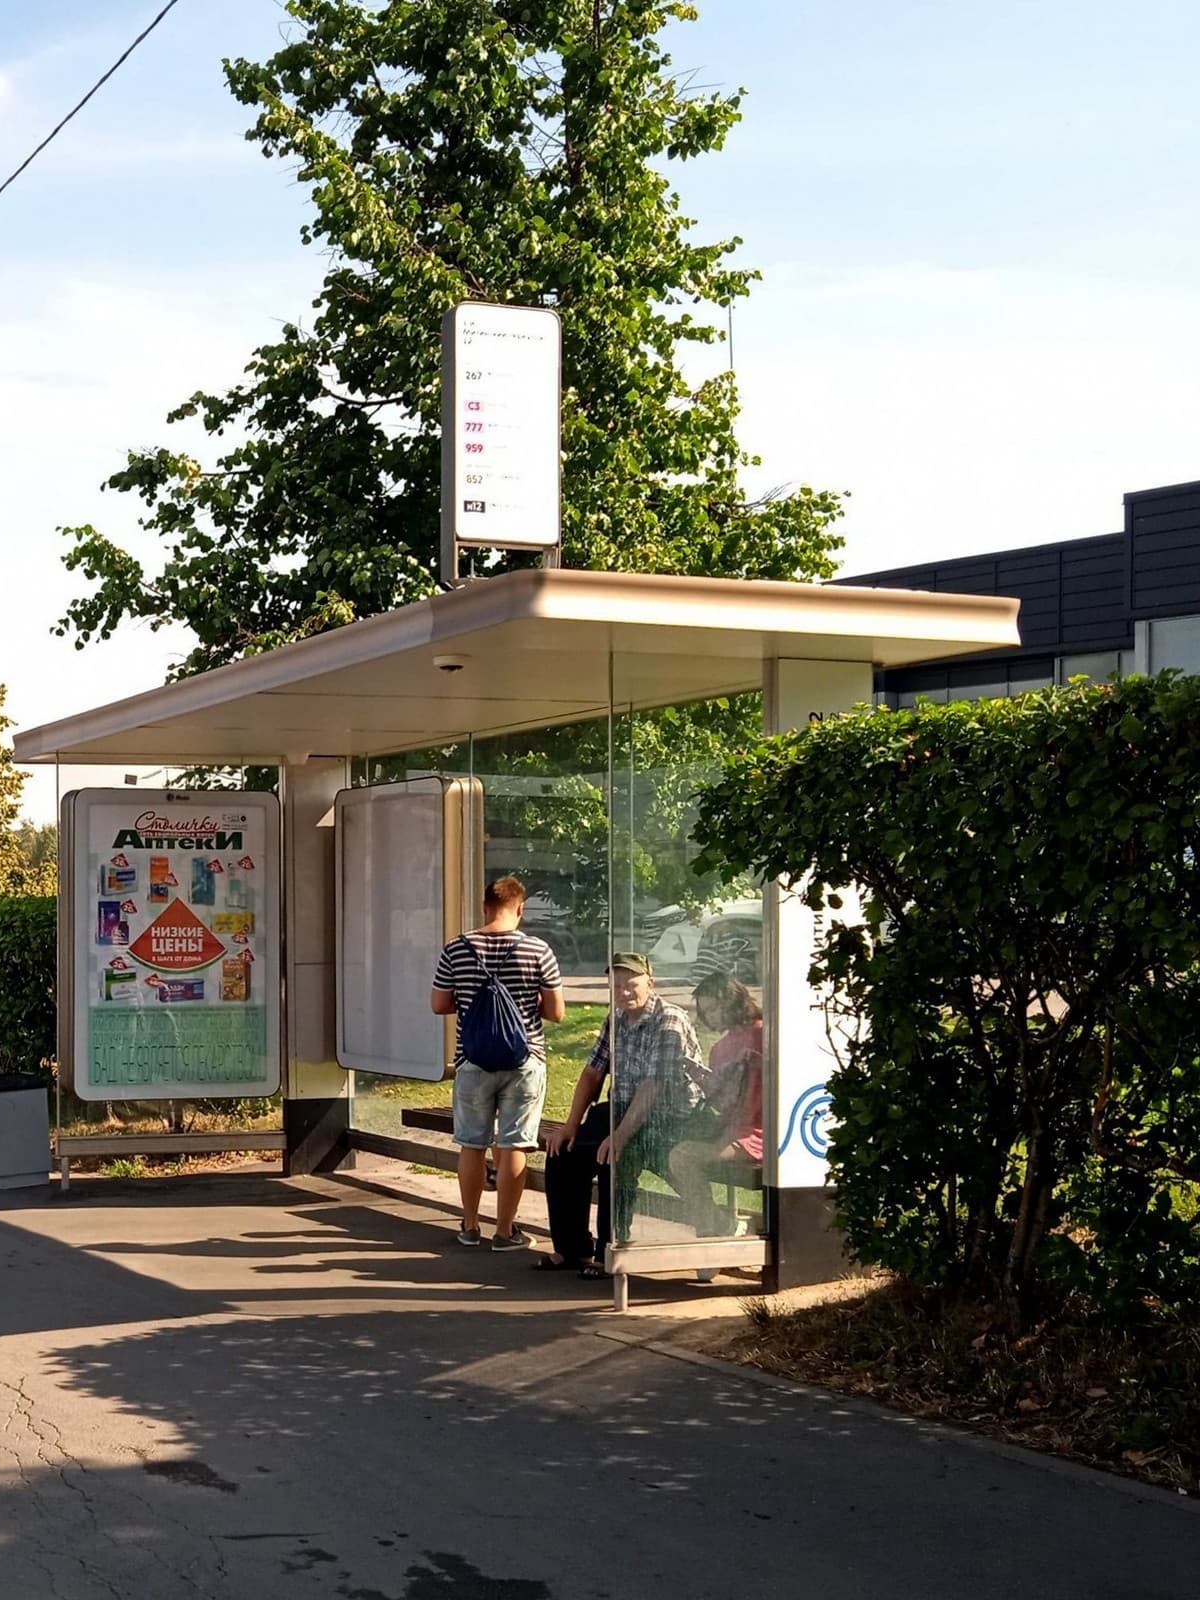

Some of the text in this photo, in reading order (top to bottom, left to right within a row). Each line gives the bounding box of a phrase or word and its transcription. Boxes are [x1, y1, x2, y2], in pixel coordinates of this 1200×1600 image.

[465, 371, 482, 380] 267
[465, 422, 483, 432] 777
[465, 443, 484, 453] 959
[133, 811, 221, 831] Столички
[151, 926, 204, 938] НИЗКИЕ
[152, 938, 203, 954] ЦЕНЫ
